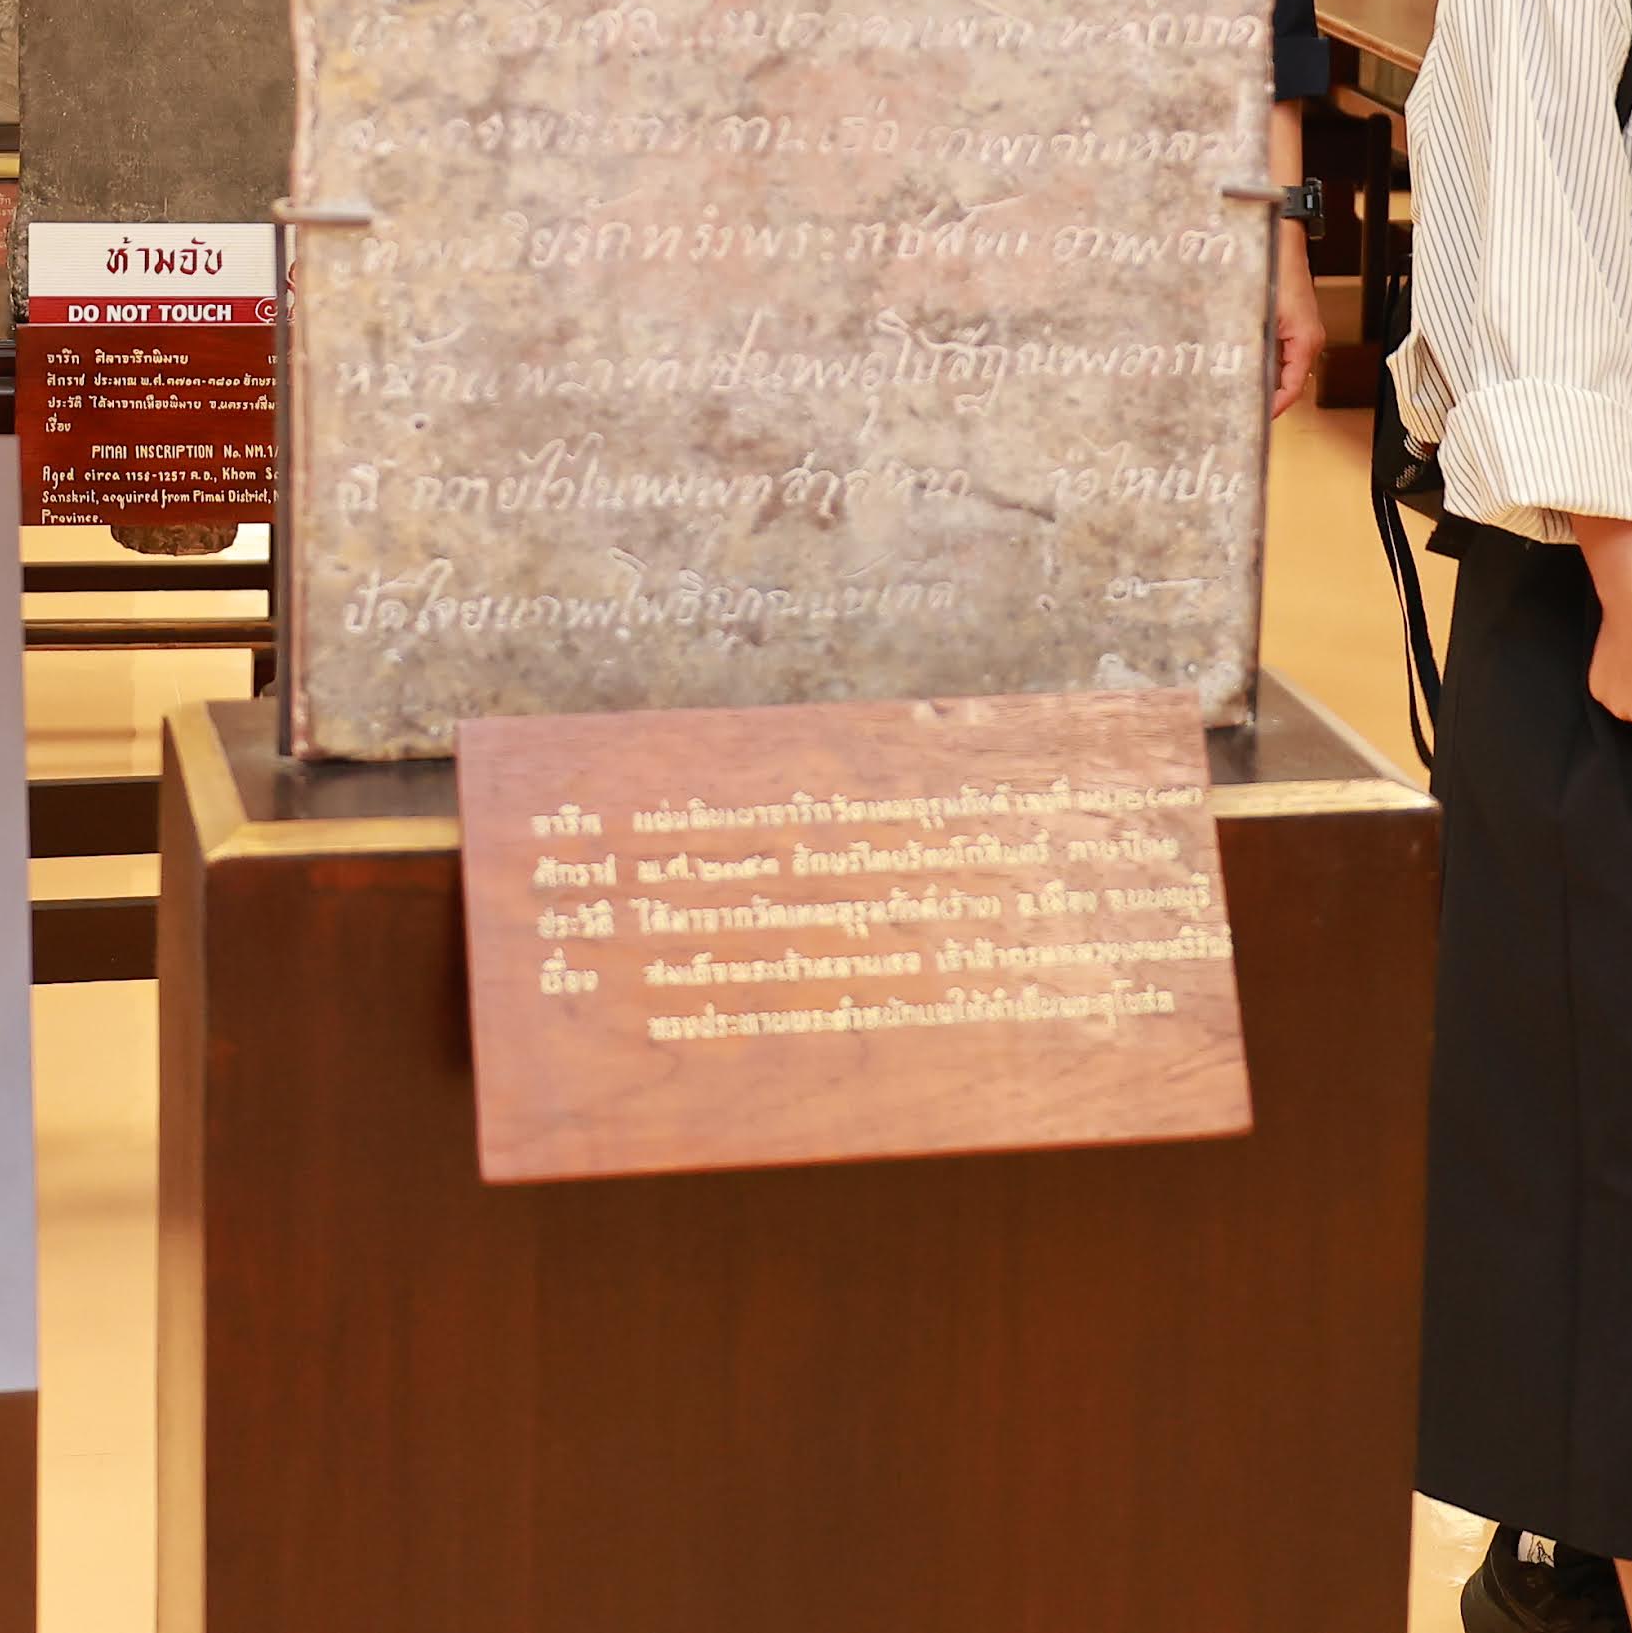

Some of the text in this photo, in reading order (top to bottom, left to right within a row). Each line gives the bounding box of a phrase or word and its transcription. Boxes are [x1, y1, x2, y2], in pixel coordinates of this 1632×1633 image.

[106, 236, 223, 275] ห้ามจับ
[68, 304, 232, 322] DO NOT TOUCH
[47, 347, 189, 365] จารึก ศิลาจารึกพิมาย
[46, 371, 86, 386] ศักราช
[93, 373, 137, 387] ประมาณ
[47, 394, 277, 411] ประวัติ ได้มาจากเมืองพิมาย จ.นครราชสีม
[45, 413, 72, 434] เรื่อง
[91, 444, 128, 459] PIMAI
[135, 444, 214, 459] INSCRIPTION
[223, 444, 242, 458] No.
[42, 465, 76, 489] Aged
[84, 467, 121, 481] circa
[125, 470, 186, 482] 1158-1257
[222, 466, 256, 481] Khom
[42, 489, 273, 510] Sanskrit, acquired from Pimai District,
[41, 509, 104, 524] Province.
